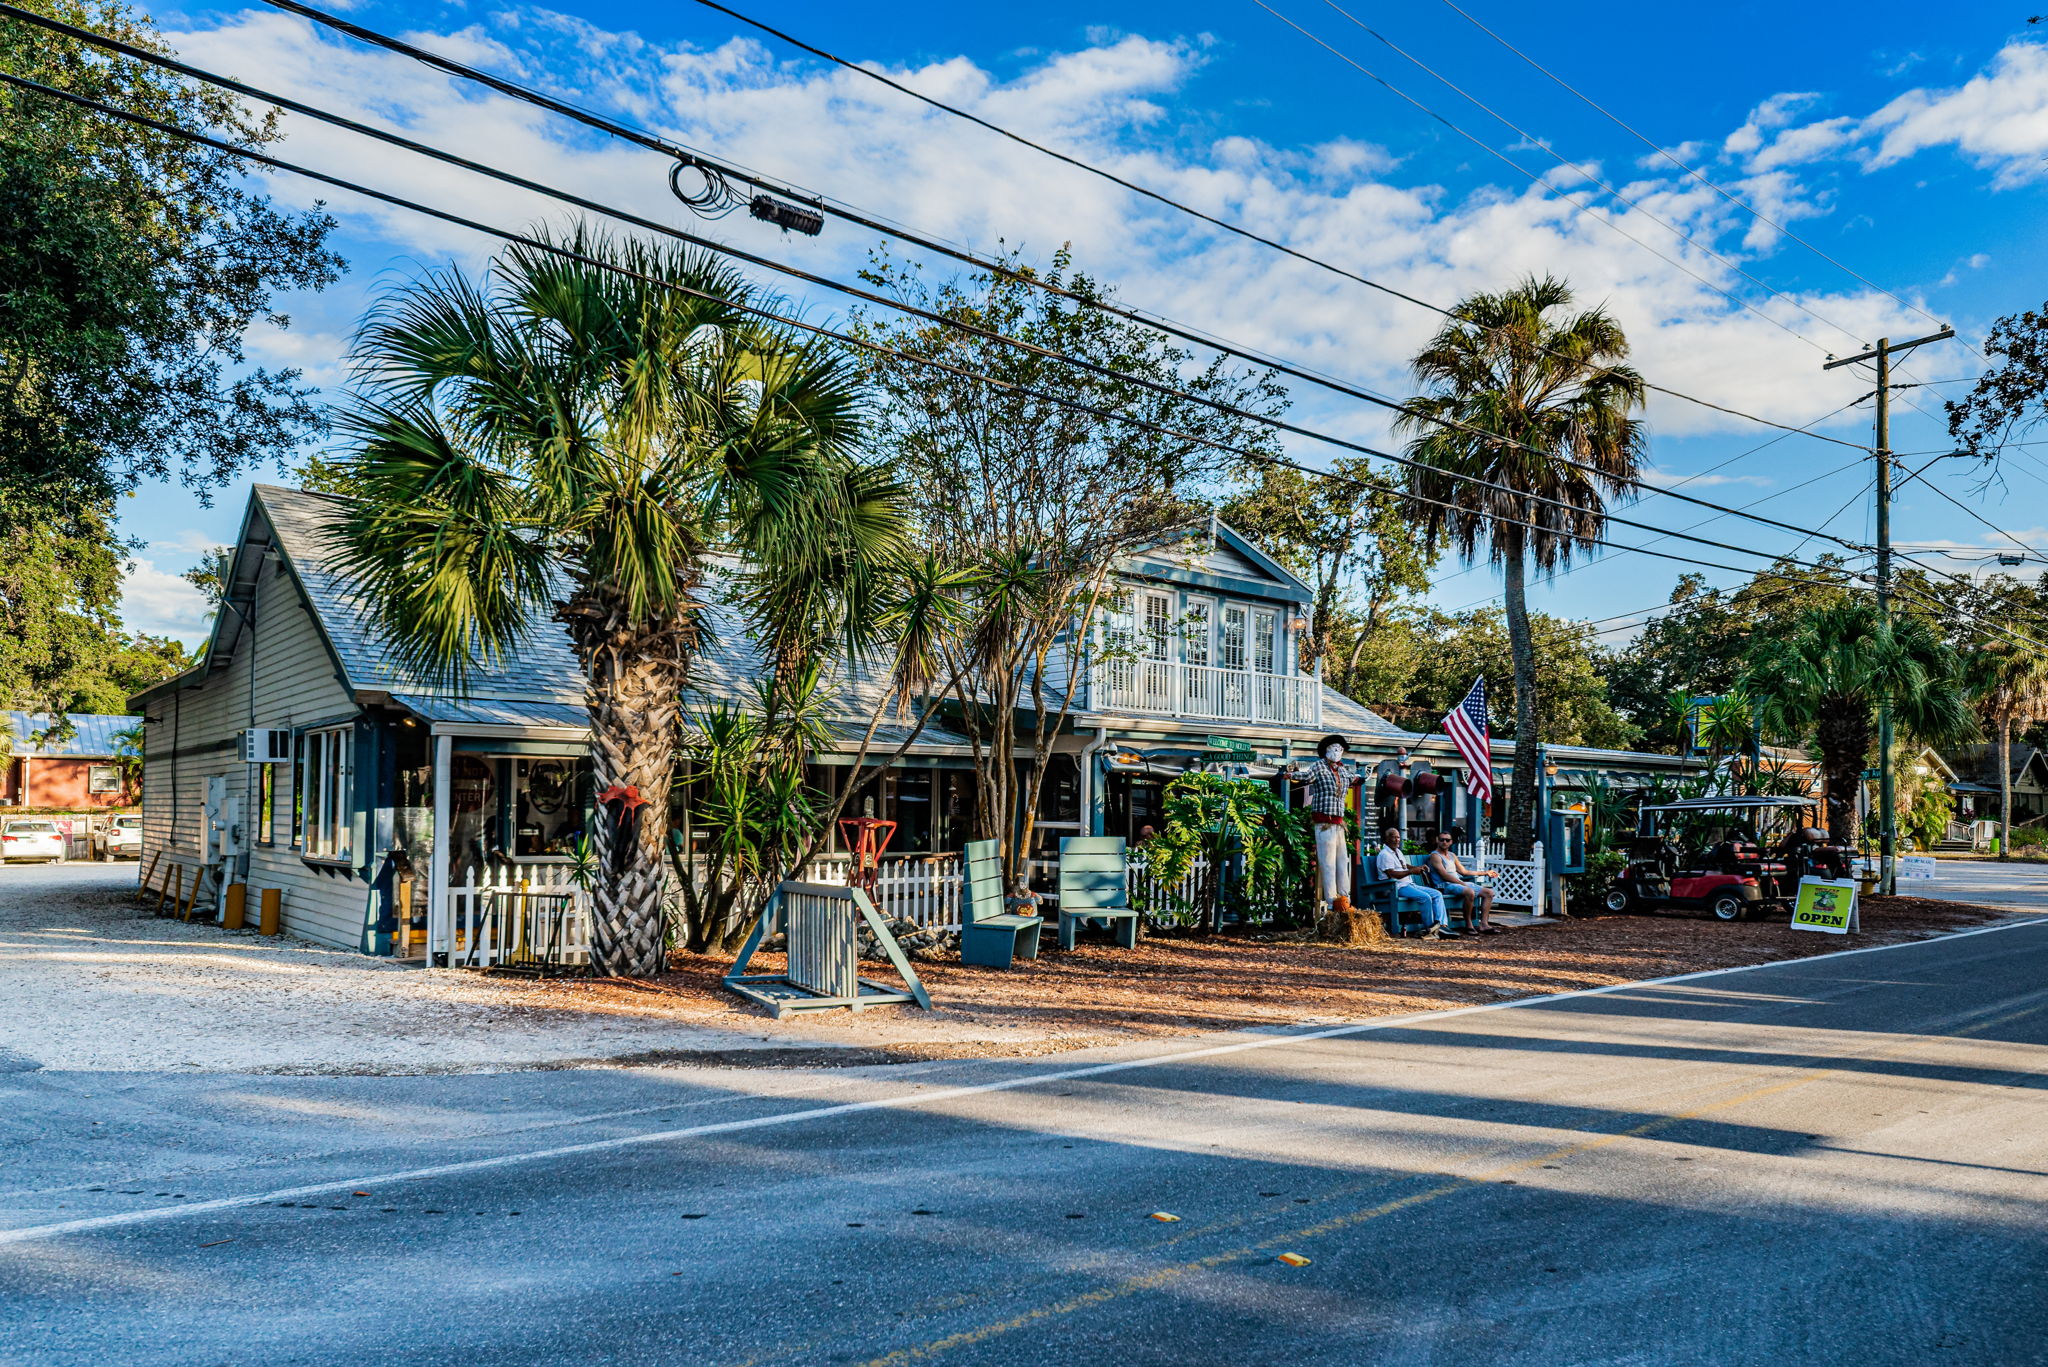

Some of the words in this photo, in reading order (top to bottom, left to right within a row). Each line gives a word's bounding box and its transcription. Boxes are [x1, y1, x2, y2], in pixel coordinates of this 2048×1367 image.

[1208, 738, 1228, 748] WELCOME
[1229, 741, 1235, 749] TO
[1213, 752, 1231, 761] GOOD
[1232, 752, 1253, 761] THING
[462, 767, 484, 777] NOT
[1799, 912, 1844, 926] OPEN
